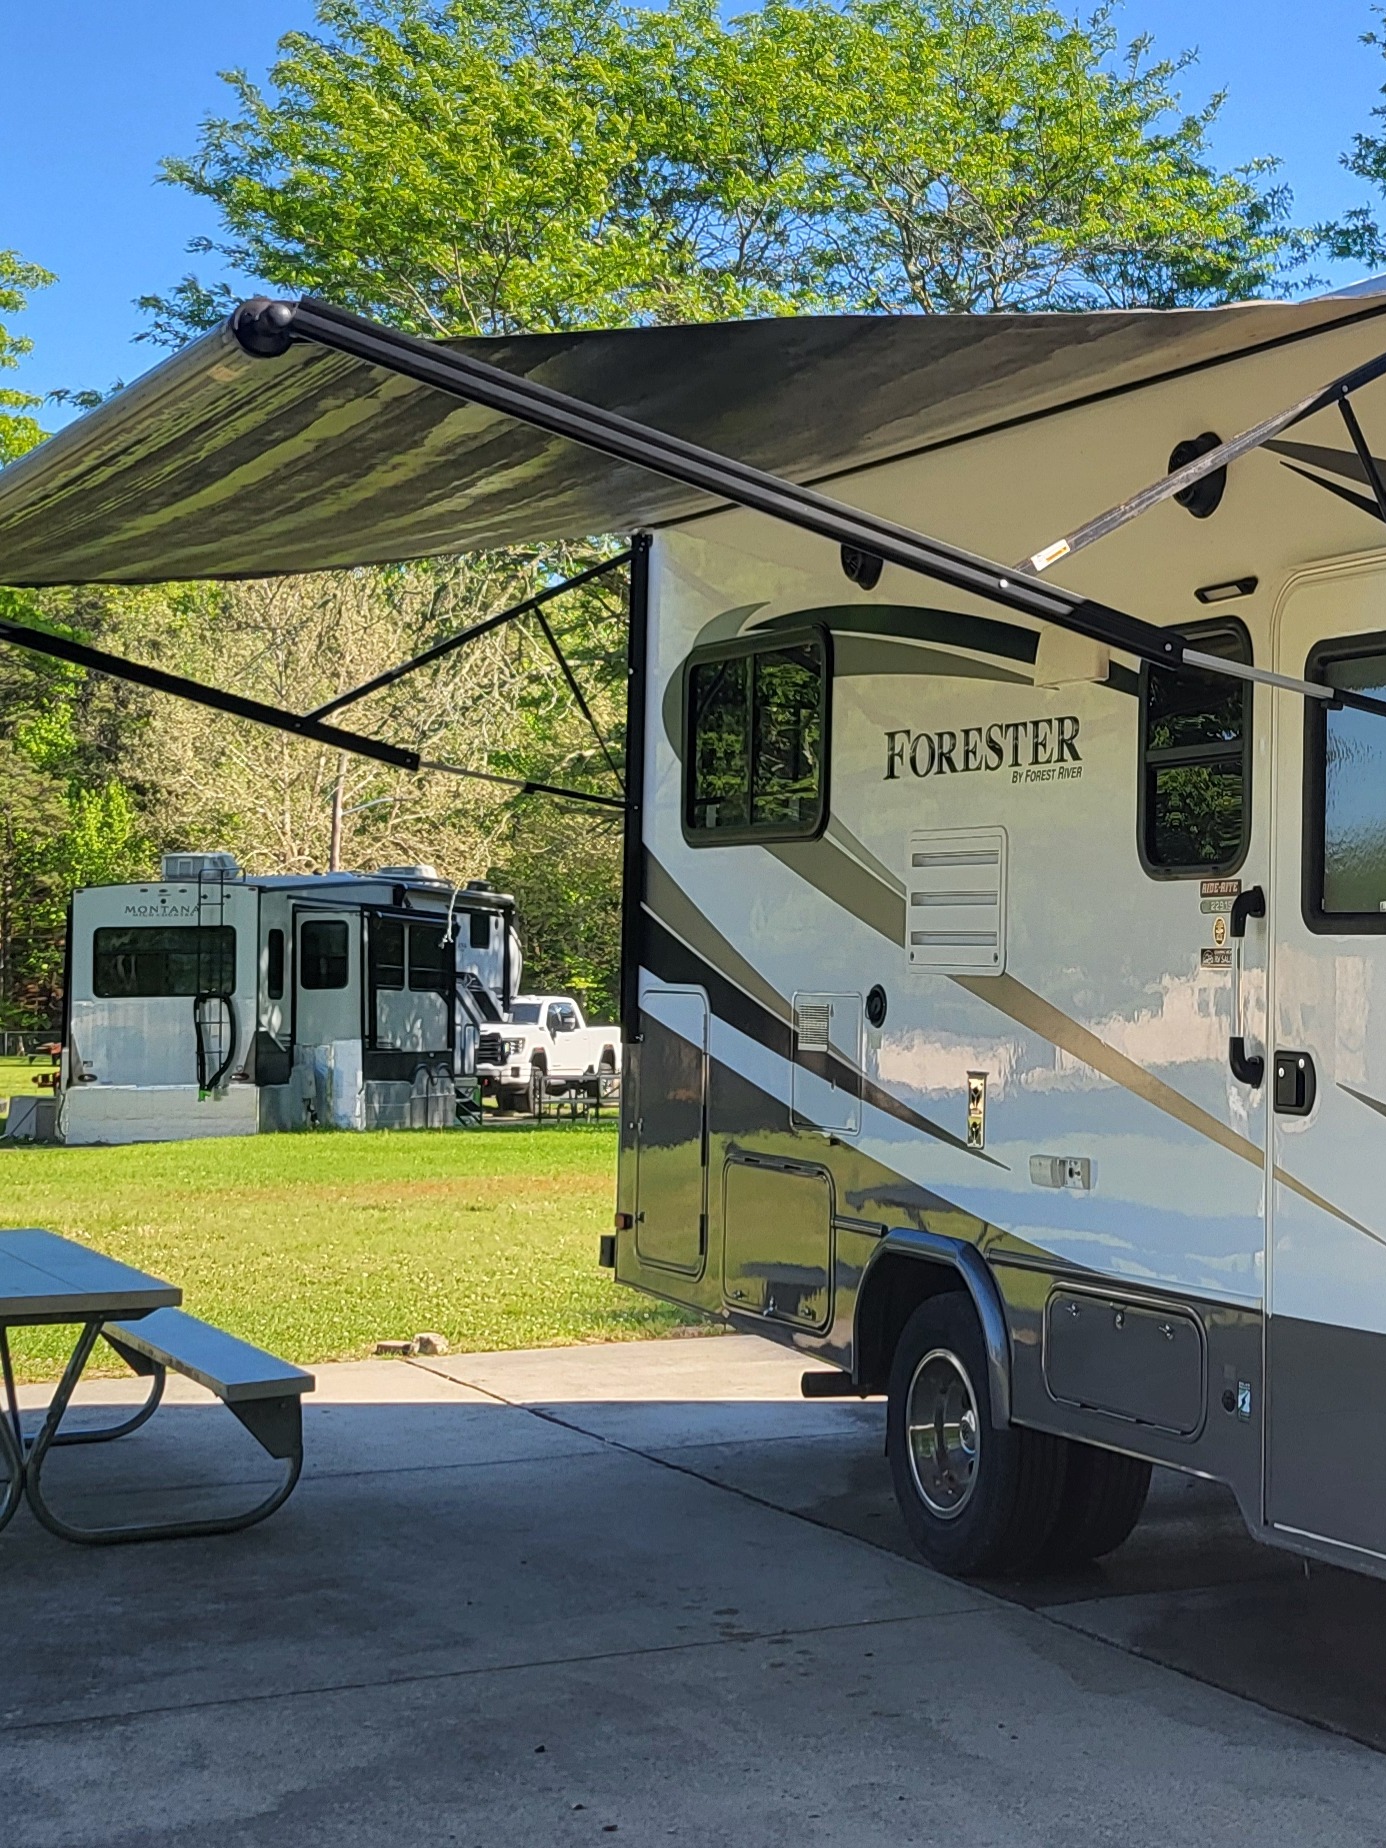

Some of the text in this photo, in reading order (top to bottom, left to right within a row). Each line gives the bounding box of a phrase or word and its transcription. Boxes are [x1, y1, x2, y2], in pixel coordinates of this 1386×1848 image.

[883, 715, 1083, 780] FORESTER
[1012, 766, 1082, 783] BY FOREST RIVER
[124, 905, 200, 914] MONTANA
